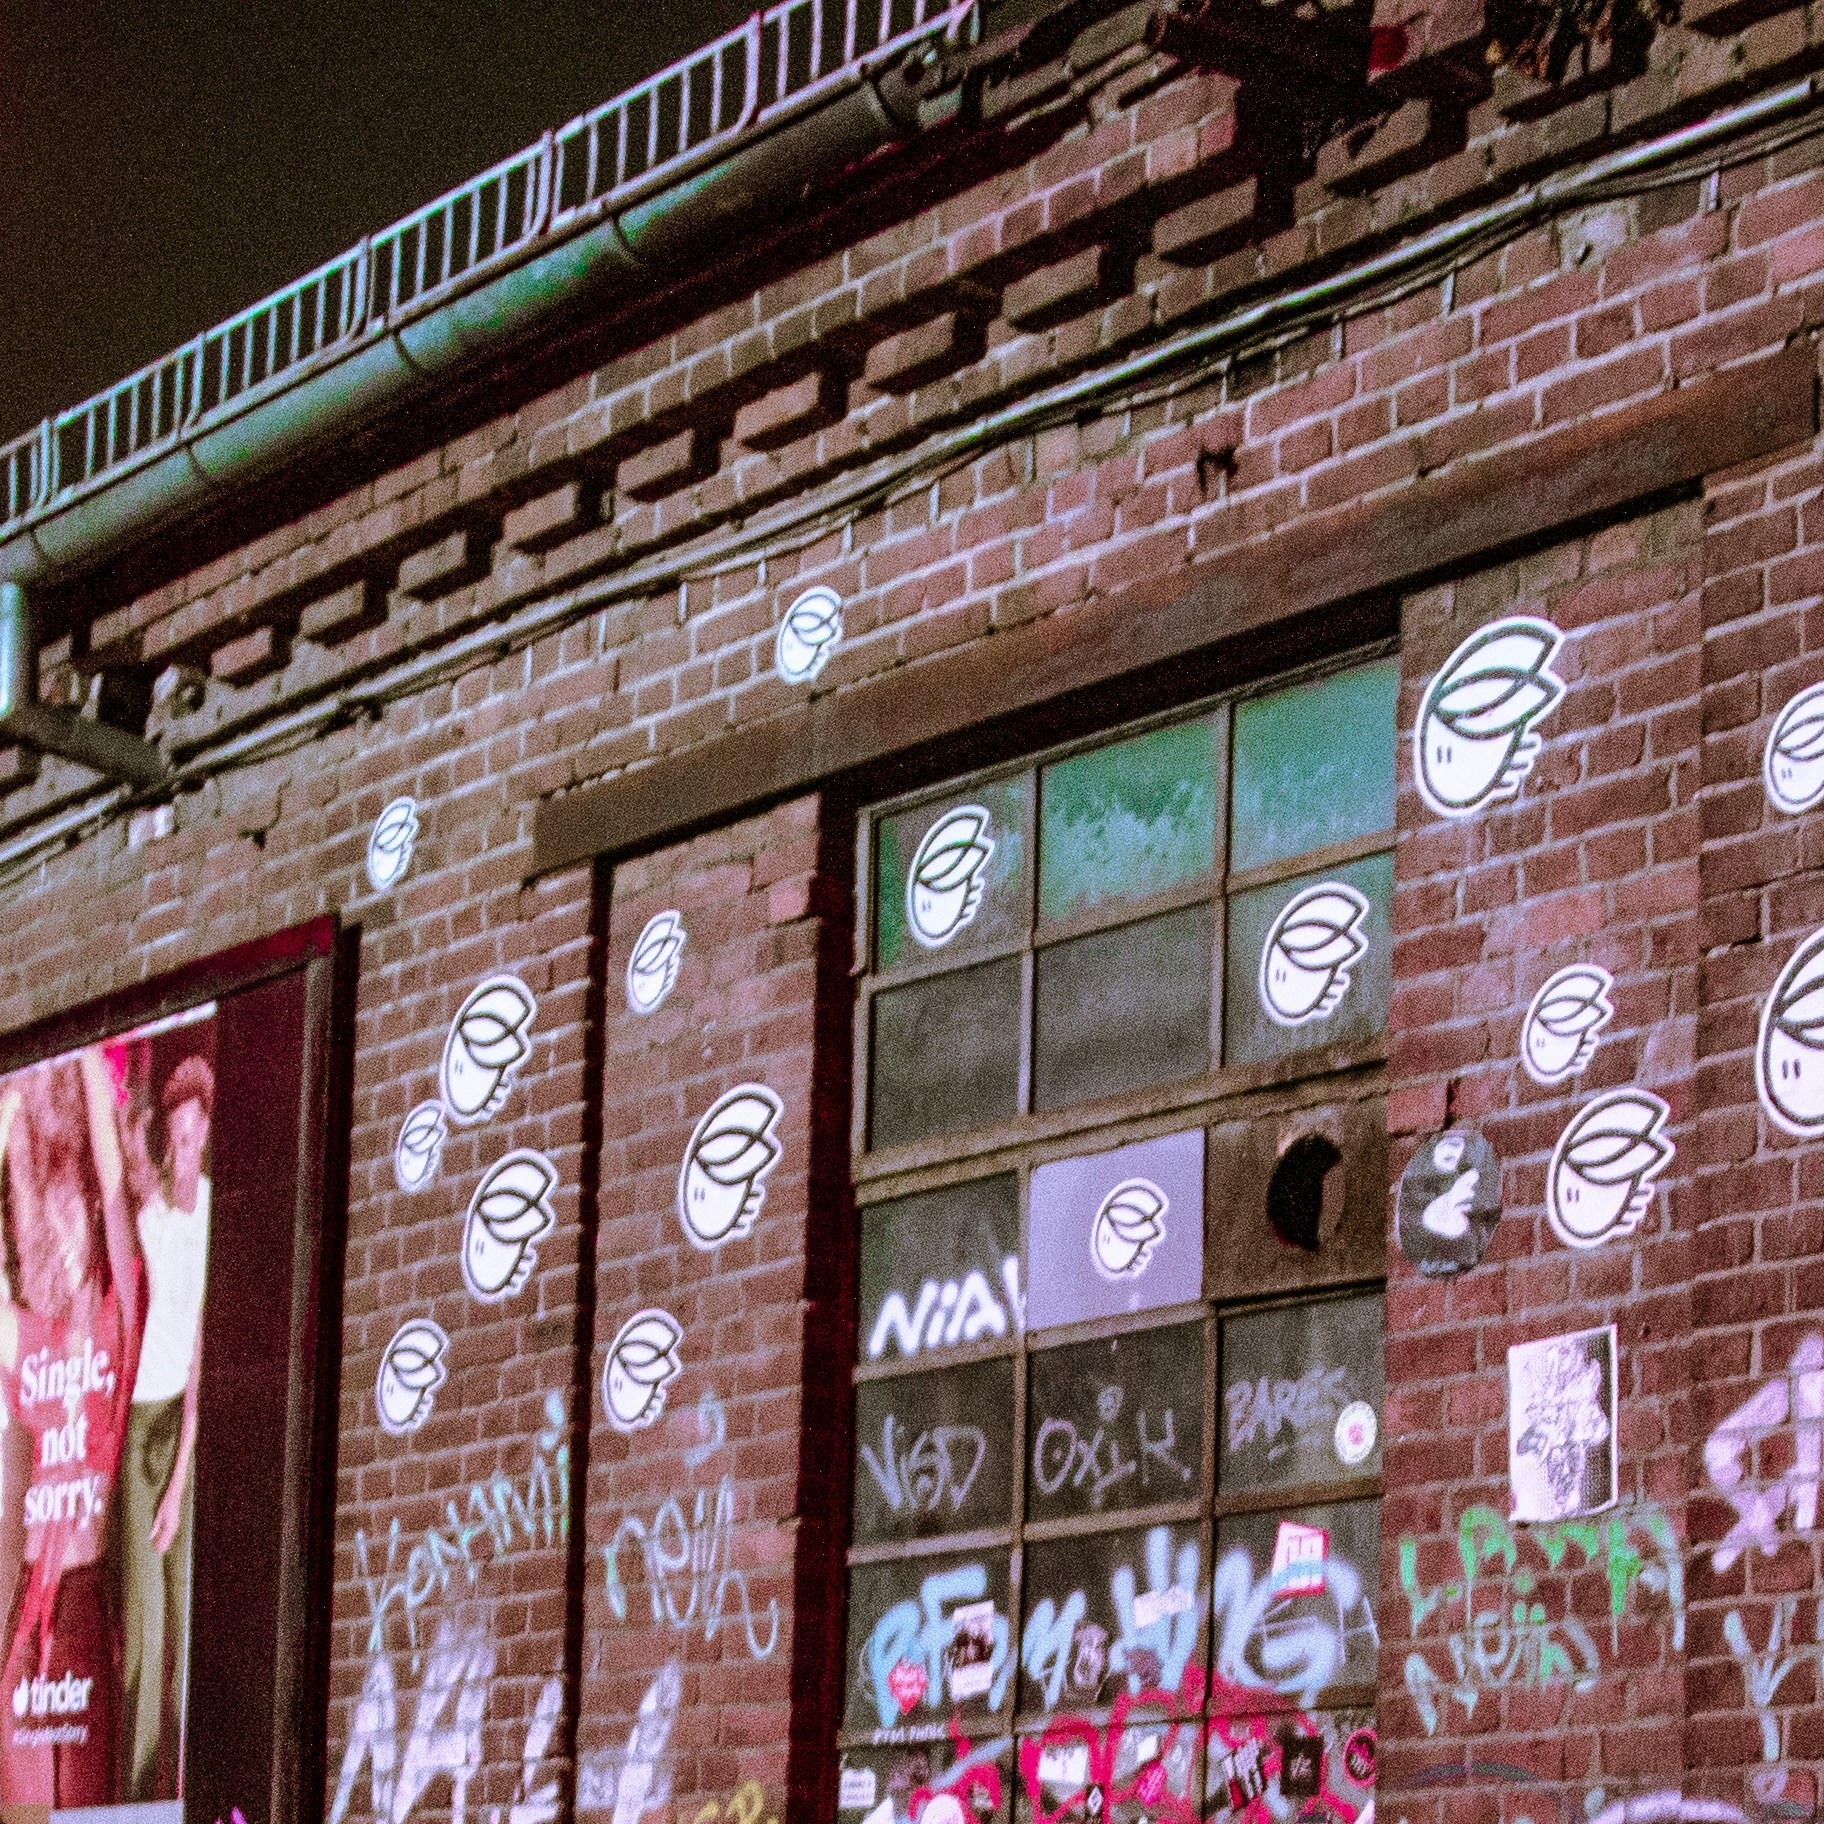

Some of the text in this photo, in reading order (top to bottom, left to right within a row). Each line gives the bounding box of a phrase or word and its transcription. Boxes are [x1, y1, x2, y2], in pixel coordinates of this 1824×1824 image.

[21, 1338, 115, 1404] Single,
[41, 1415, 87, 1465] not
[26, 1475, 104, 1532] sorry.
[31, 1672, 93, 1716] tinder
